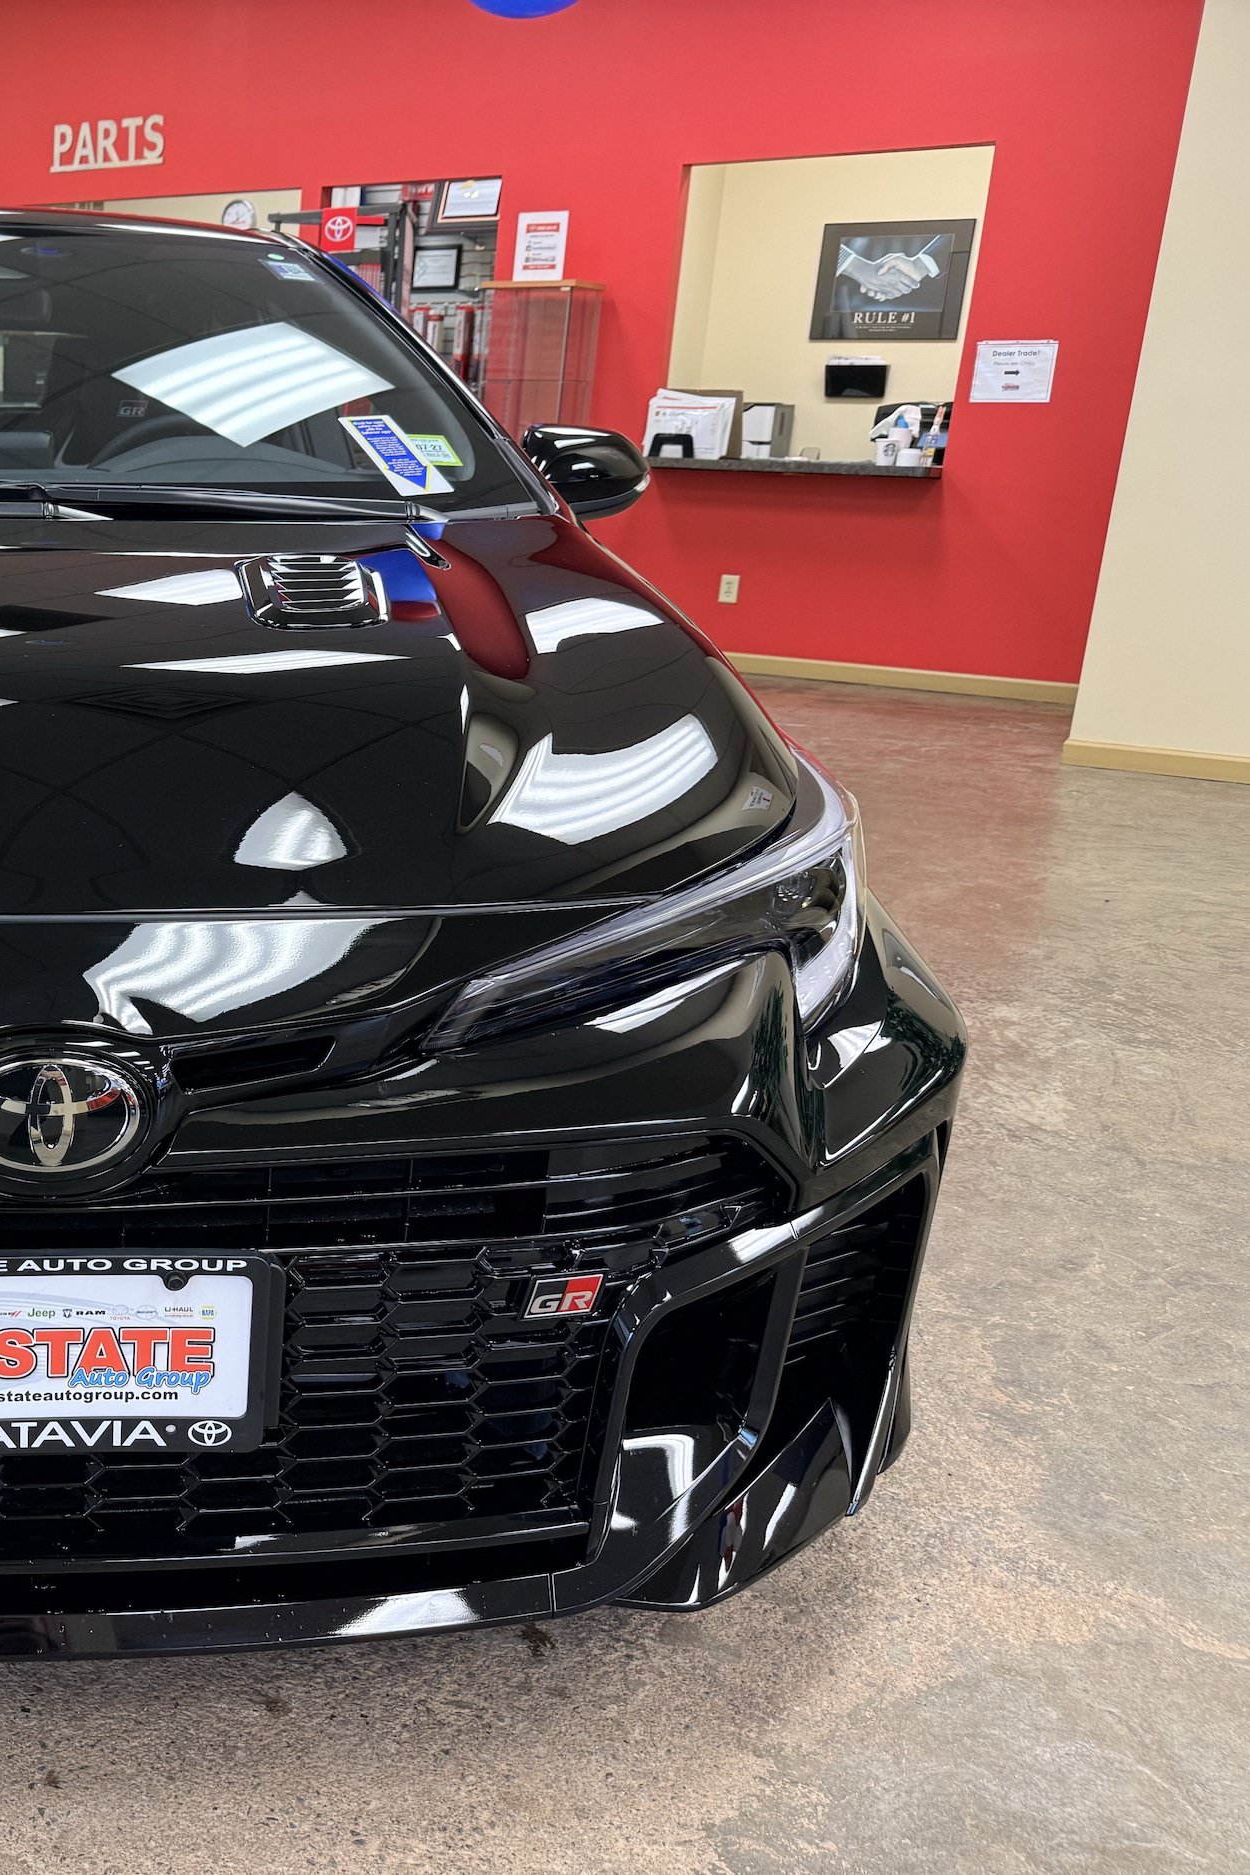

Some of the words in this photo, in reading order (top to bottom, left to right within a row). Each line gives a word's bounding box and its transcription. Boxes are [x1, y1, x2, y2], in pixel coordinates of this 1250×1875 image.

[52, 113, 165, 169] PARTS
[853, 311, 898, 324] RULE
[901, 311, 916, 324] #1
[1017, 349, 1041, 357] Trade?
[119, 406, 146, 416] GR
[16, 1258, 113, 1273] AUTO
[122, 1258, 248, 1272] GROUP
[530, 1290, 594, 1314] GR
[27, 1307, 56, 1319] Jeep
[68, 1368, 129, 1389] Auto
[136, 1366, 212, 1395] Group
